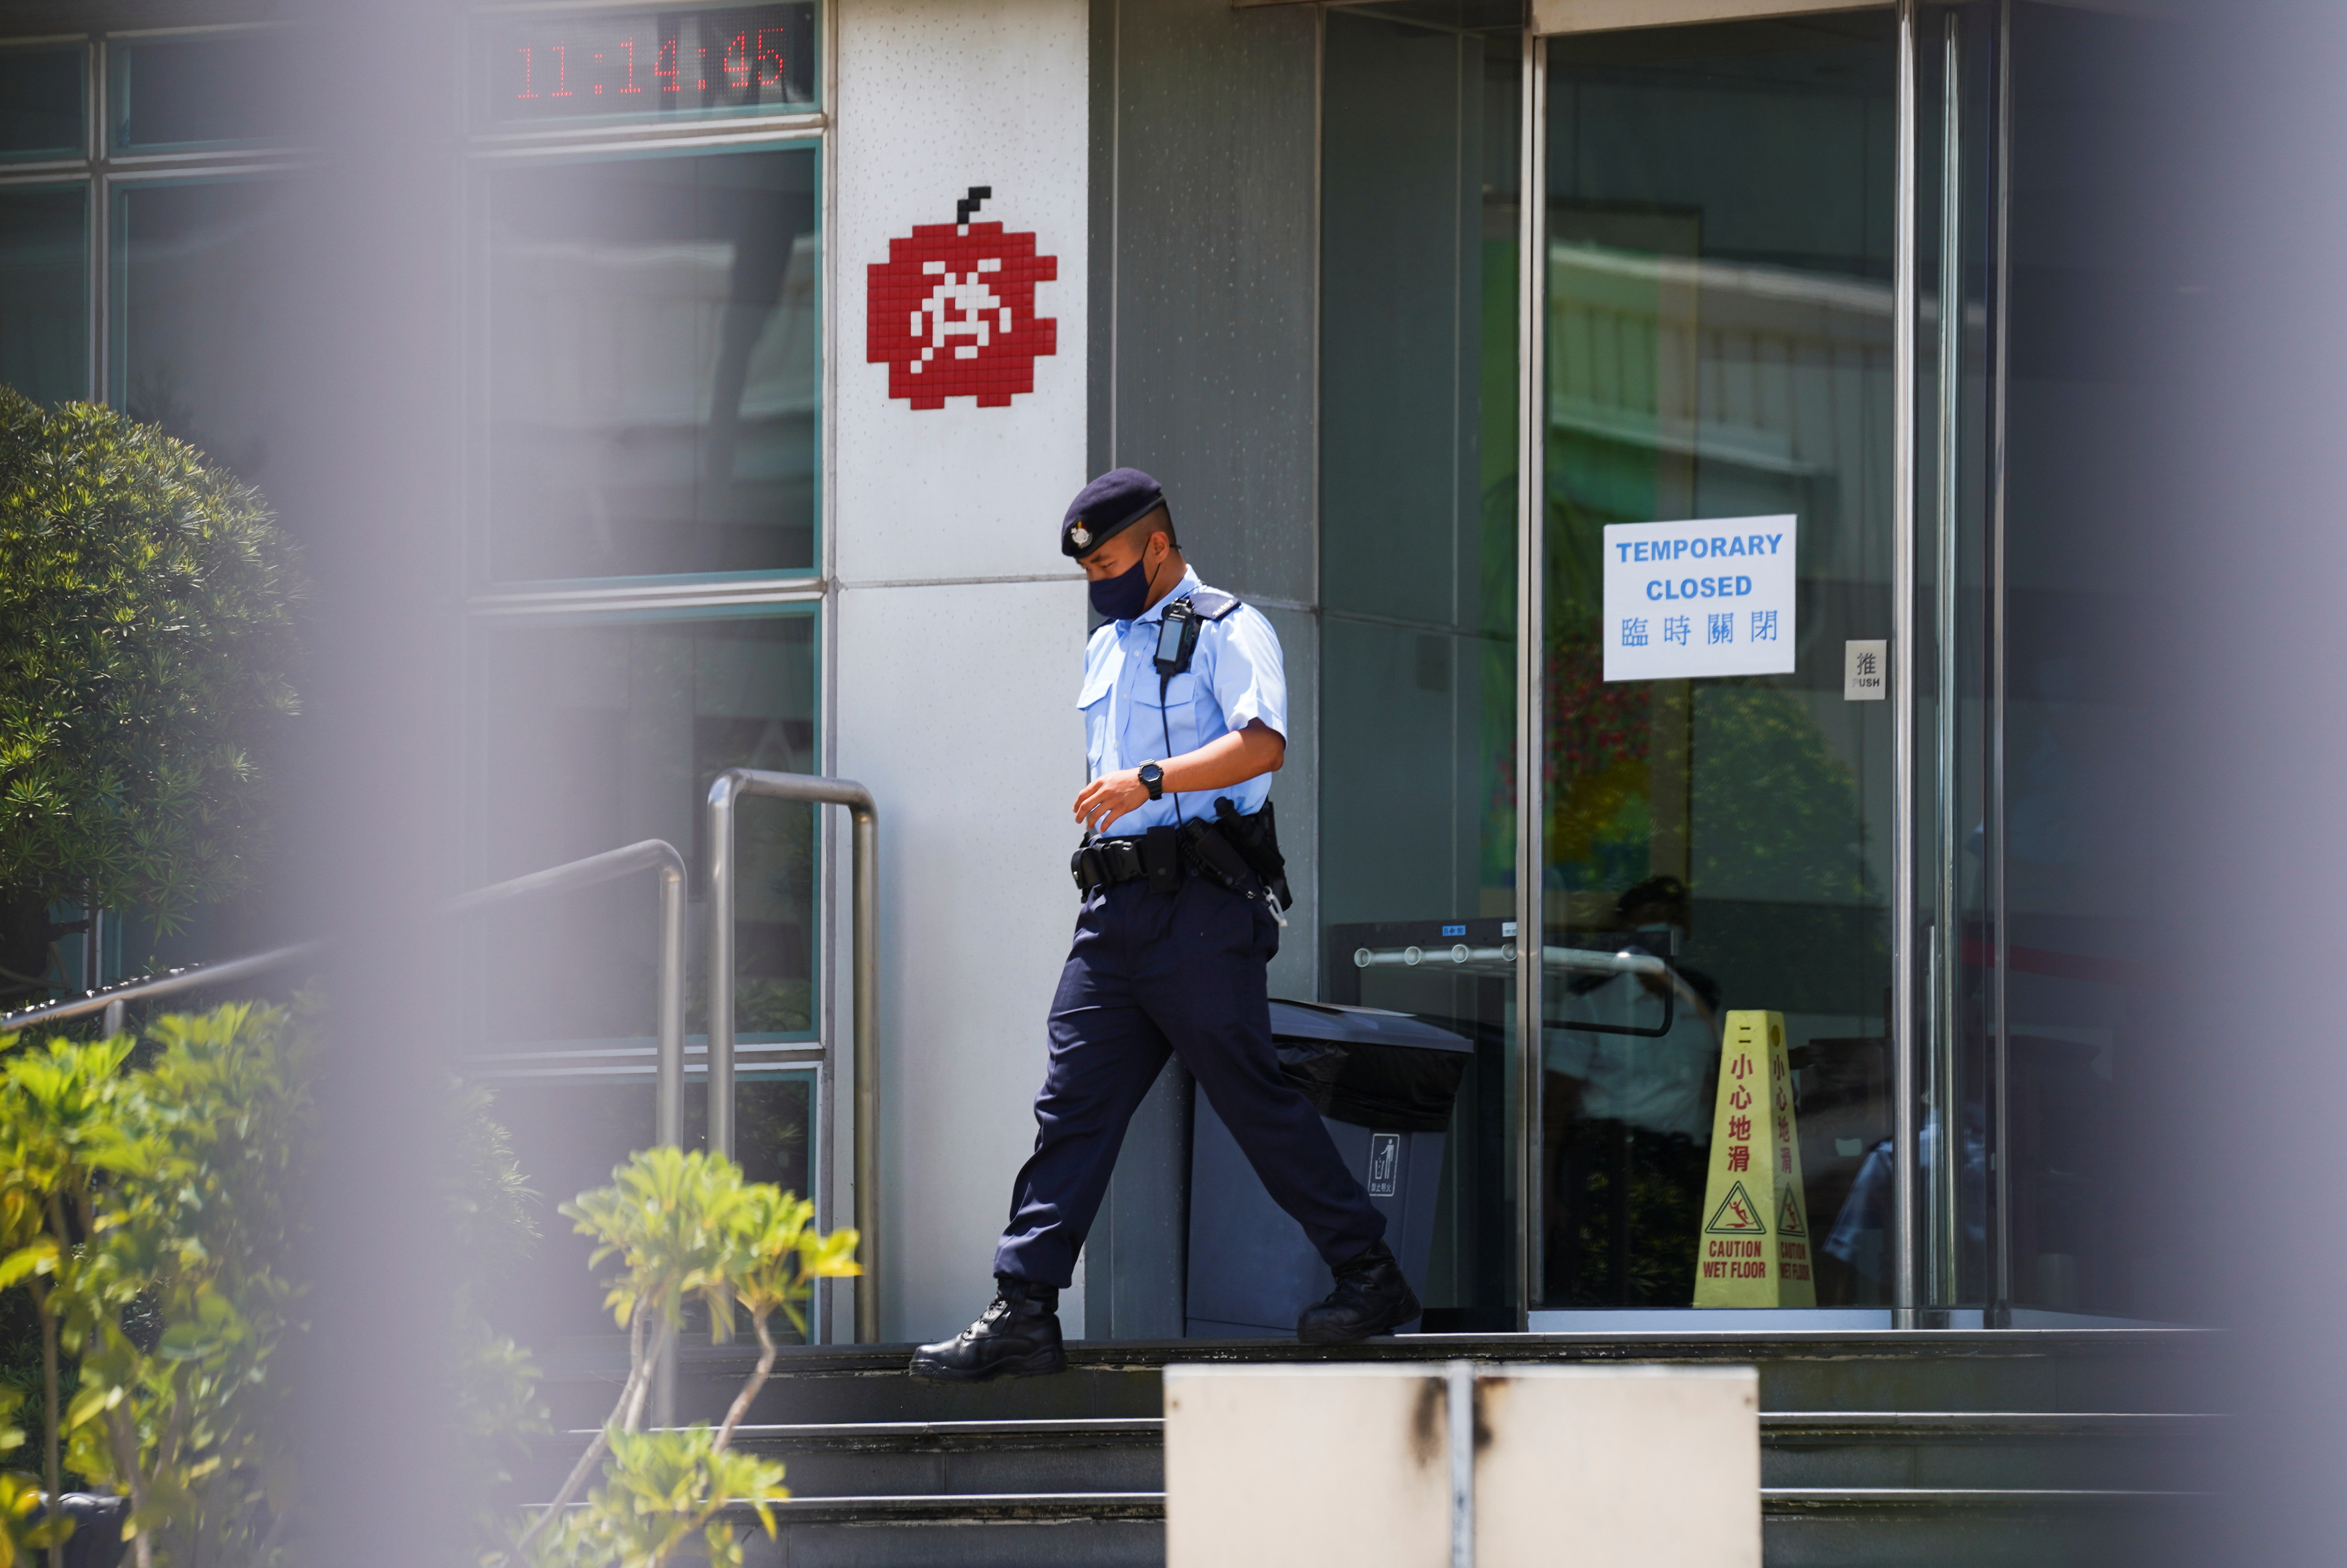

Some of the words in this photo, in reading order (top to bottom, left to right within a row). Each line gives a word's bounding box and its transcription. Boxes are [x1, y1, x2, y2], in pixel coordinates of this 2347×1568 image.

[518, 28, 784, 98] 11:14:45
[1616, 533, 1783, 563] TEMPORARY
[1646, 575, 1752, 601] CLOSED
[1621, 610, 1778, 647] 臨時關閉
[1857, 653, 1877, 675] 推
[1727, 1053, 1753, 1172] 小心地滑
[1773, 1054, 1792, 1174] 小心地滑
[1709, 1240, 1762, 1258] CAUTION
[1703, 1261, 1728, 1278] WET
[1730, 1262, 1766, 1278] FLOOR
